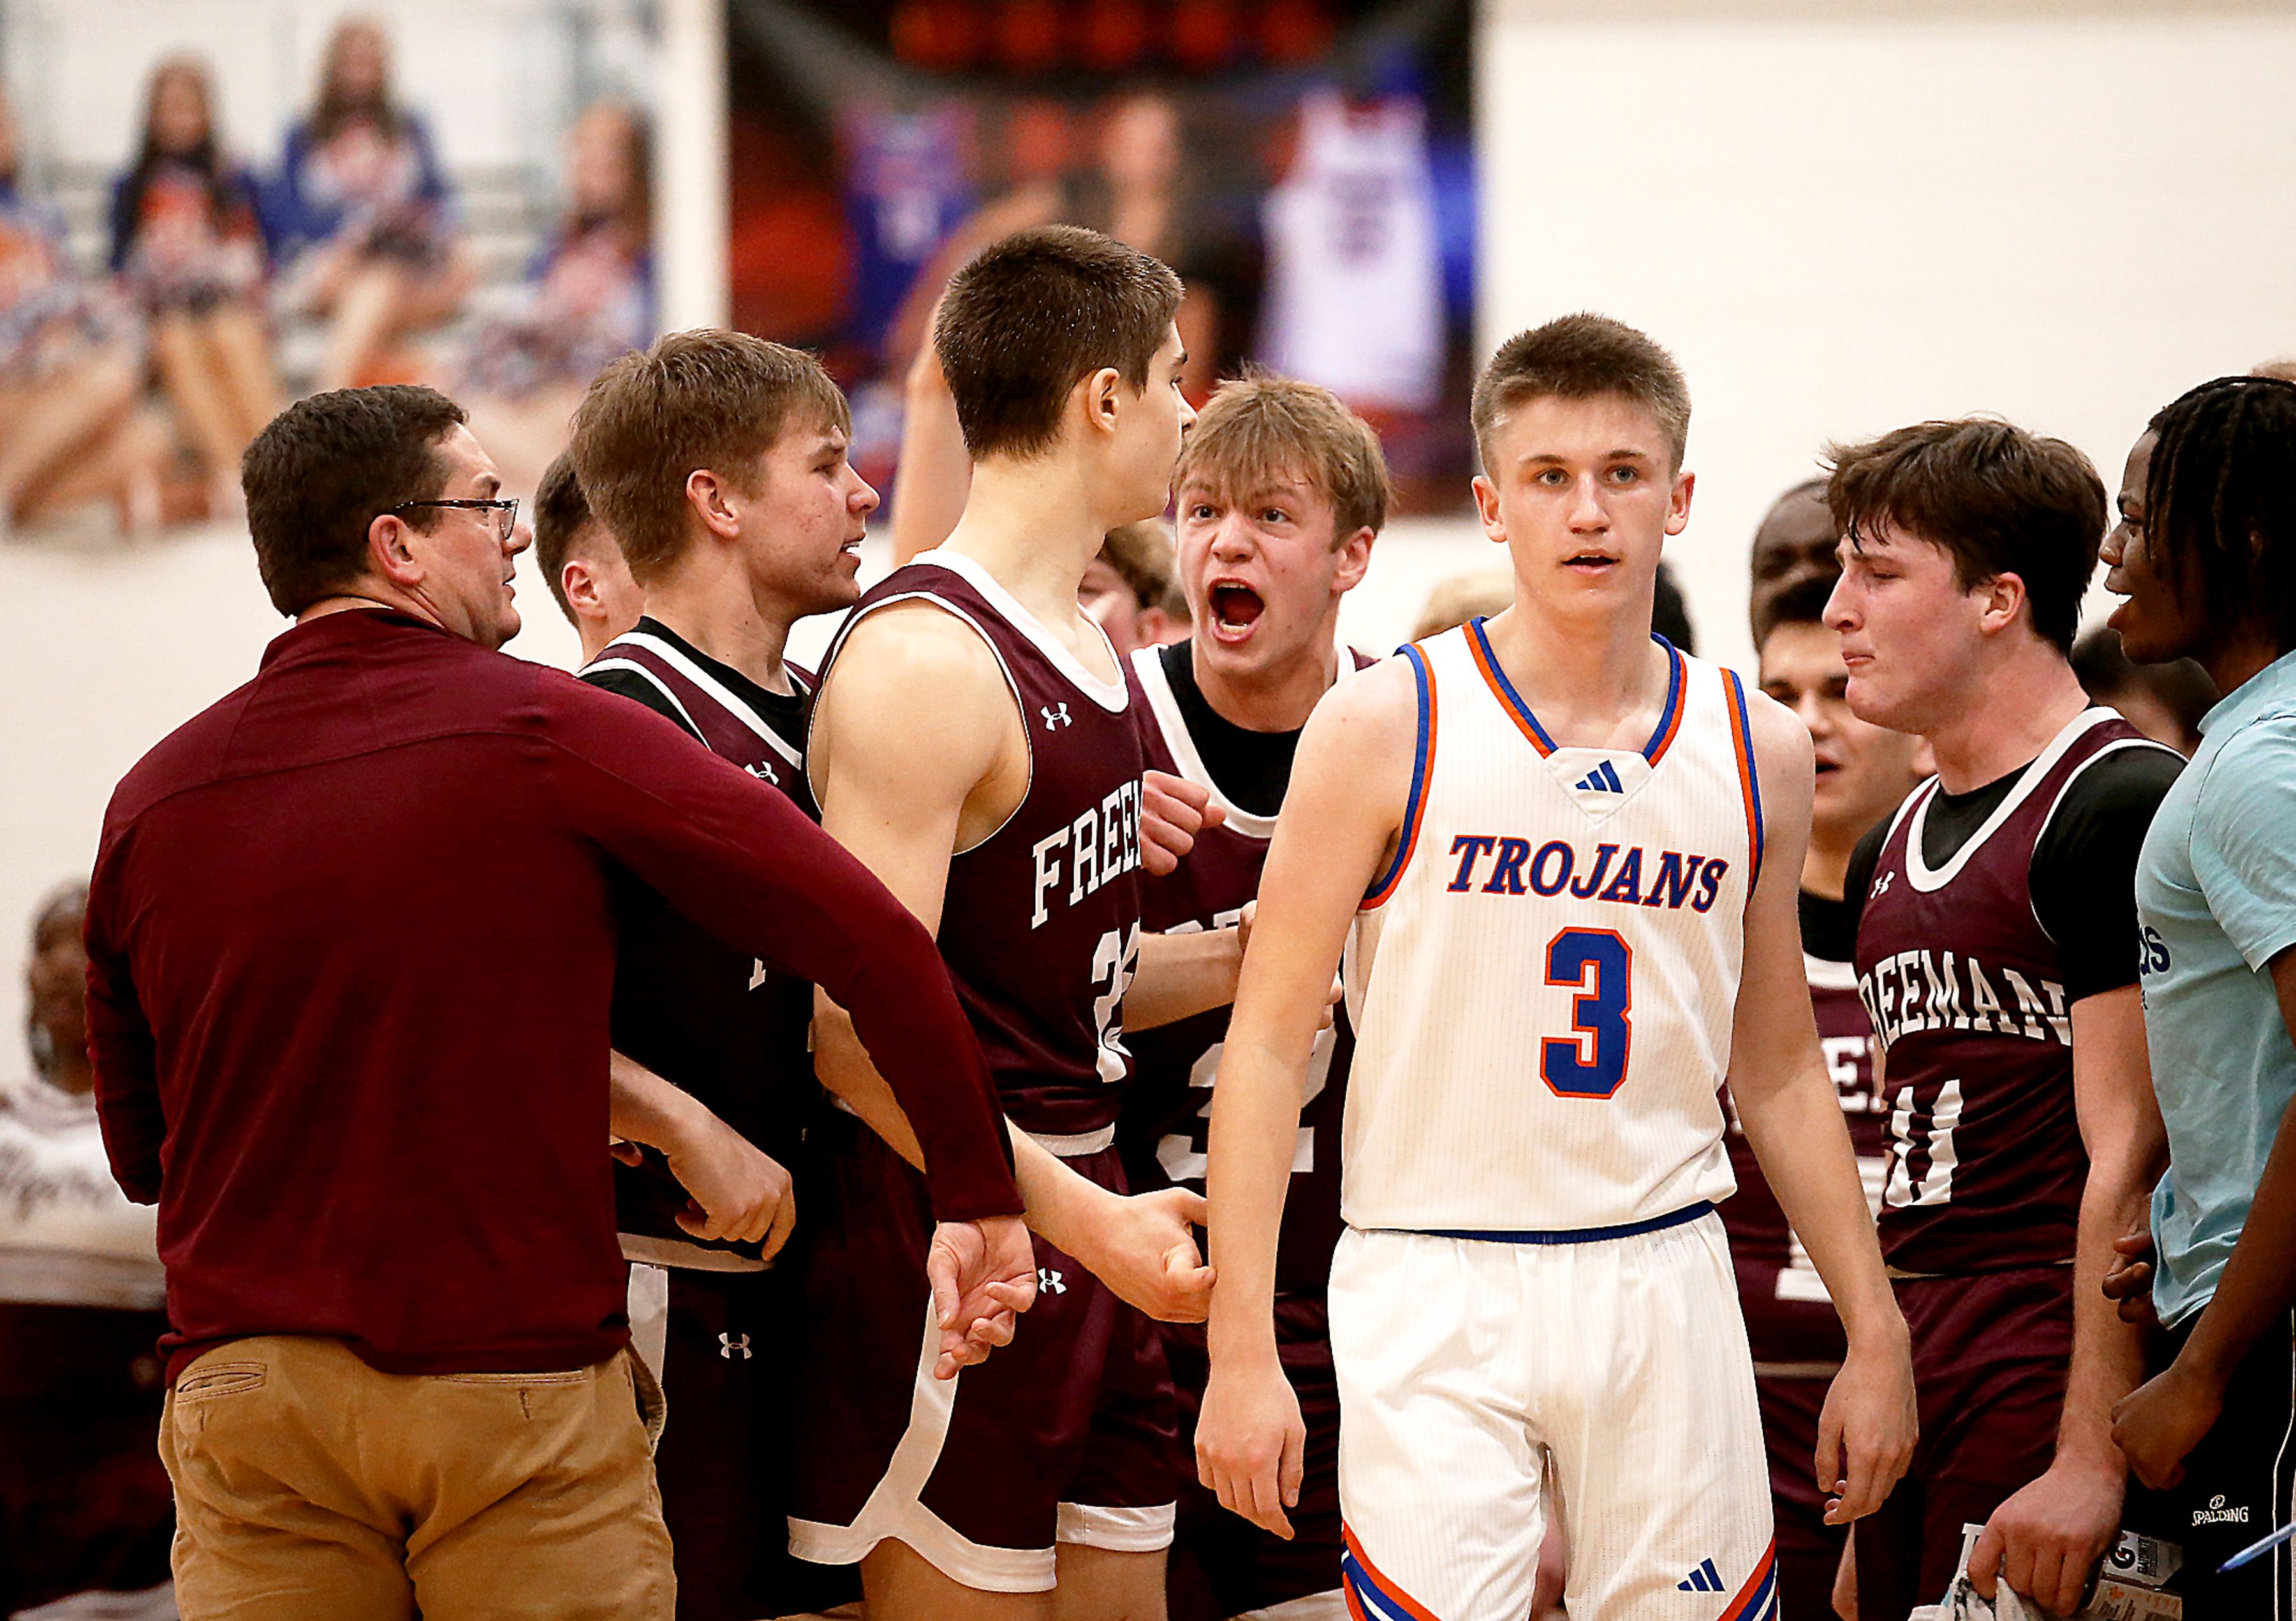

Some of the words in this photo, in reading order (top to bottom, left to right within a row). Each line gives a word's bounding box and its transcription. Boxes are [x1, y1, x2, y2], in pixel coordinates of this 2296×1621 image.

[1446, 834, 1729, 913] TROJANS
[1540, 926, 1633, 1100] 3
[1858, 950, 2072, 1052] REEMAN
[2191, 1506, 2249, 1527] SPALDING
